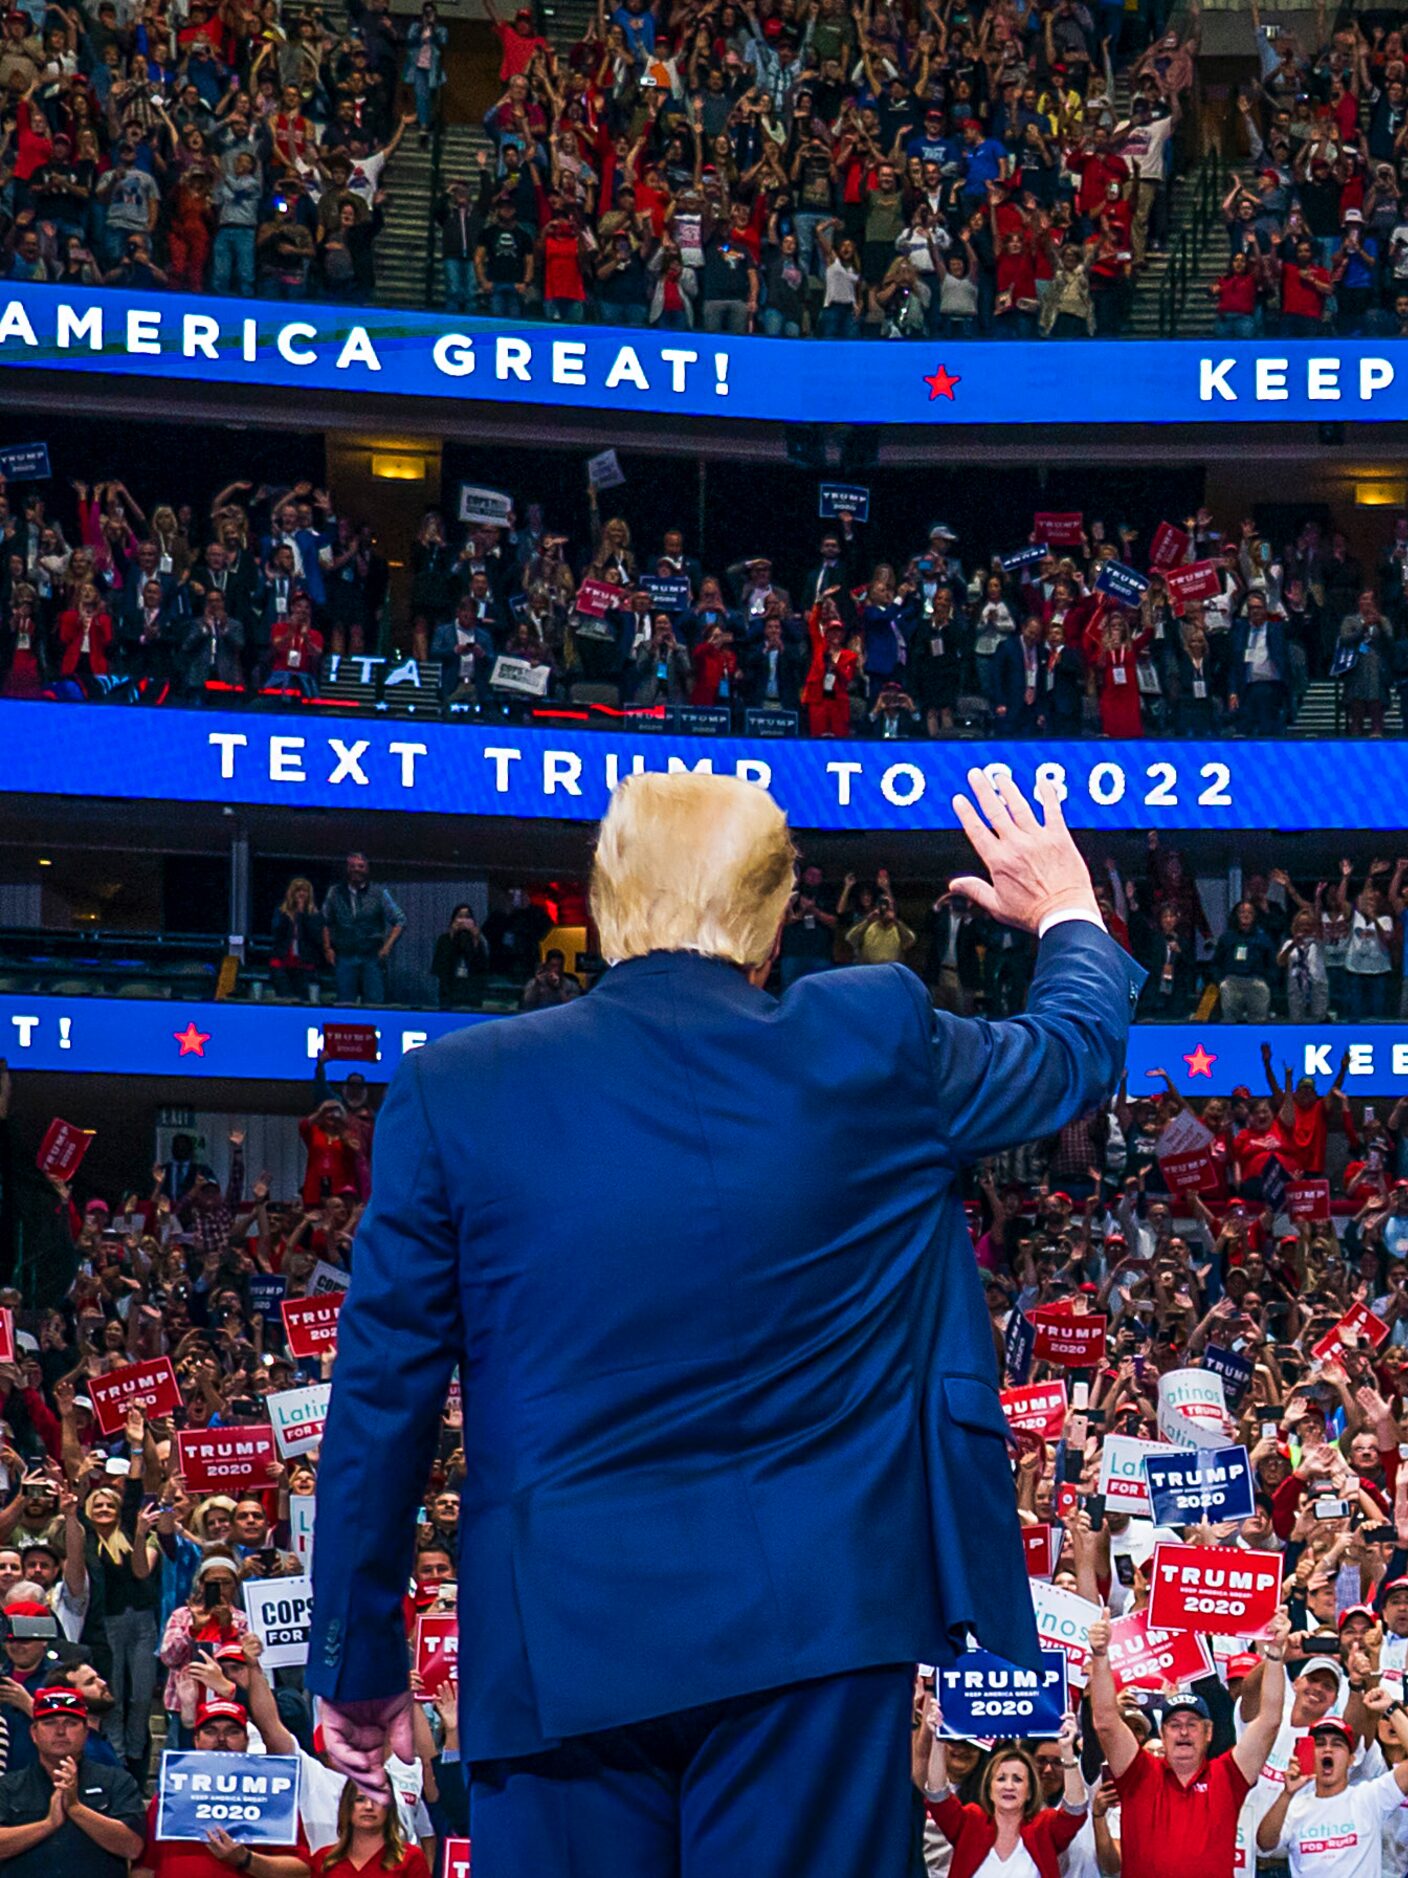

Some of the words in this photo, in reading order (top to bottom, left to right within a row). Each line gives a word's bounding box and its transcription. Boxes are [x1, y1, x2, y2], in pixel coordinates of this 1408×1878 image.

[0, 301, 382, 371] AMERICA
[433, 333, 731, 395] GREAT!
[1198, 356, 1395, 402] KEEP
[208, 732, 428, 789] TEXT
[826, 761, 926, 806] TO
[288, 1306, 341, 1326] TRU
[309, 1326, 338, 1341] 202
[1036, 1323, 1103, 1339] TRUMP
[1050, 1342, 1087, 1354] 2020
[95, 1370, 170, 1403] TRUMP
[1166, 1383, 1222, 1405] atinos
[1001, 1395, 1061, 1416] RUMP
[285, 1427, 313, 1440] FOR
[184, 1440, 272, 1459] TRUMP
[206, 1464, 253, 1477] 2020
[1151, 1463, 1245, 1488] TRUMP
[1110, 1481, 1139, 1496] FOR
[1176, 1491, 1226, 1509] 2020
[1160, 1564, 1275, 1592] TRUMP
[1183, 1596, 1246, 1616] 2020
[268, 1628, 304, 1644] FOR
[1107, 1629, 1180, 1662] RUM
[1119, 1652, 1175, 1684] 2020
[942, 1669, 1060, 1689] TRUMP
[970, 1699, 1034, 1716] 2020
[169, 1772, 292, 1795] TRUMP
[195, 1803, 262, 1821] 2020
[1301, 1841, 1324, 1853] FOR
[1327, 1835, 1357, 1848] RUMP
